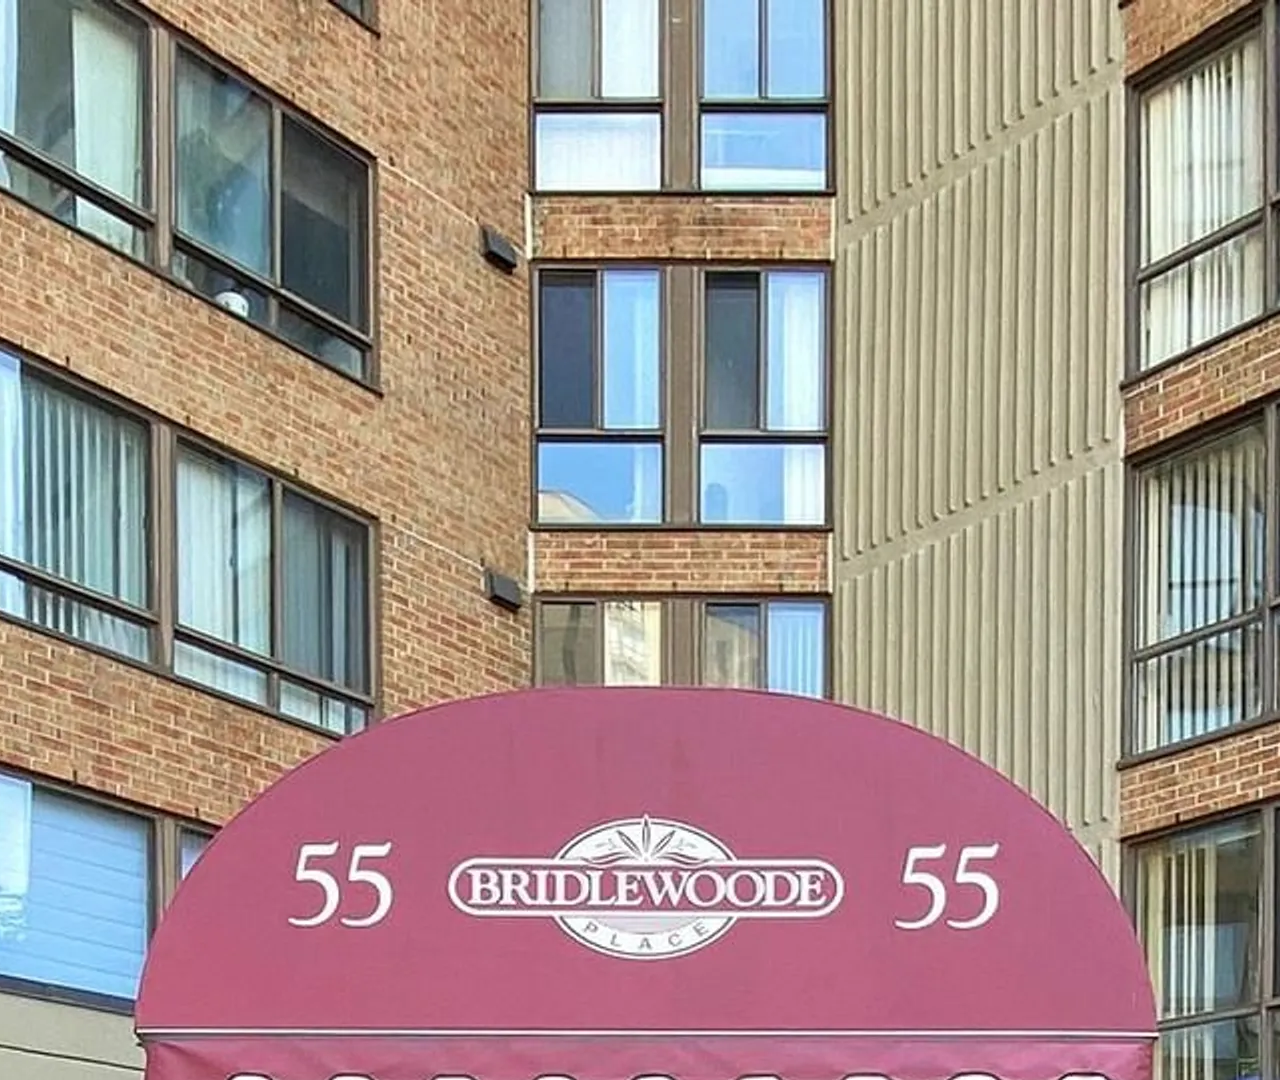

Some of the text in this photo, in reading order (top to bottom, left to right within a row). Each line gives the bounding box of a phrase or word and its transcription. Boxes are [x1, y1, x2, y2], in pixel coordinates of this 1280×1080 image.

[287, 840, 393, 928] 55
[467, 868, 826, 908] BRIDLEWOODE
[894, 842, 1001, 931] 55
[583, 920, 710, 950] PLACE
